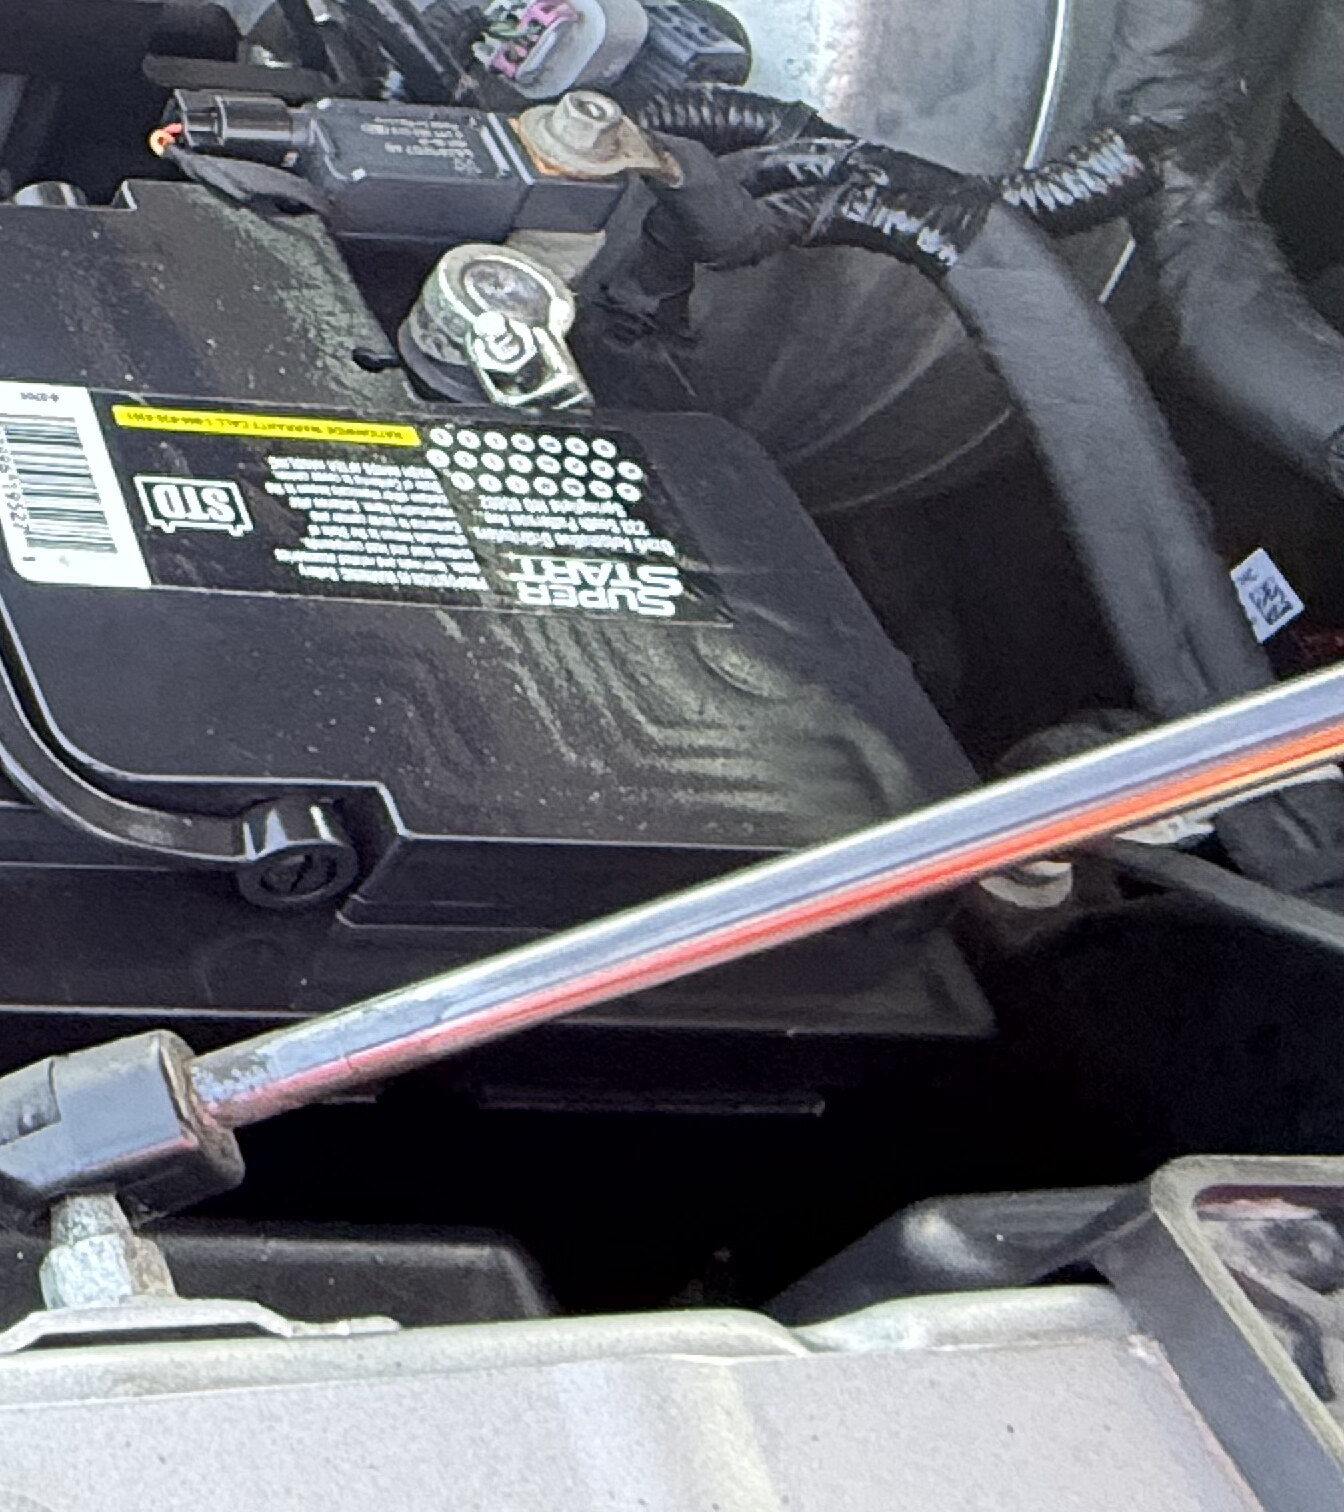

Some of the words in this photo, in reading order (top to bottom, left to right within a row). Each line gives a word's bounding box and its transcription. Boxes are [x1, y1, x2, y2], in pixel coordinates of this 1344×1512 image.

[148, 482, 237, 523] STD
[505, 554, 684, 597] START
[514, 580, 676, 617] SUPER
